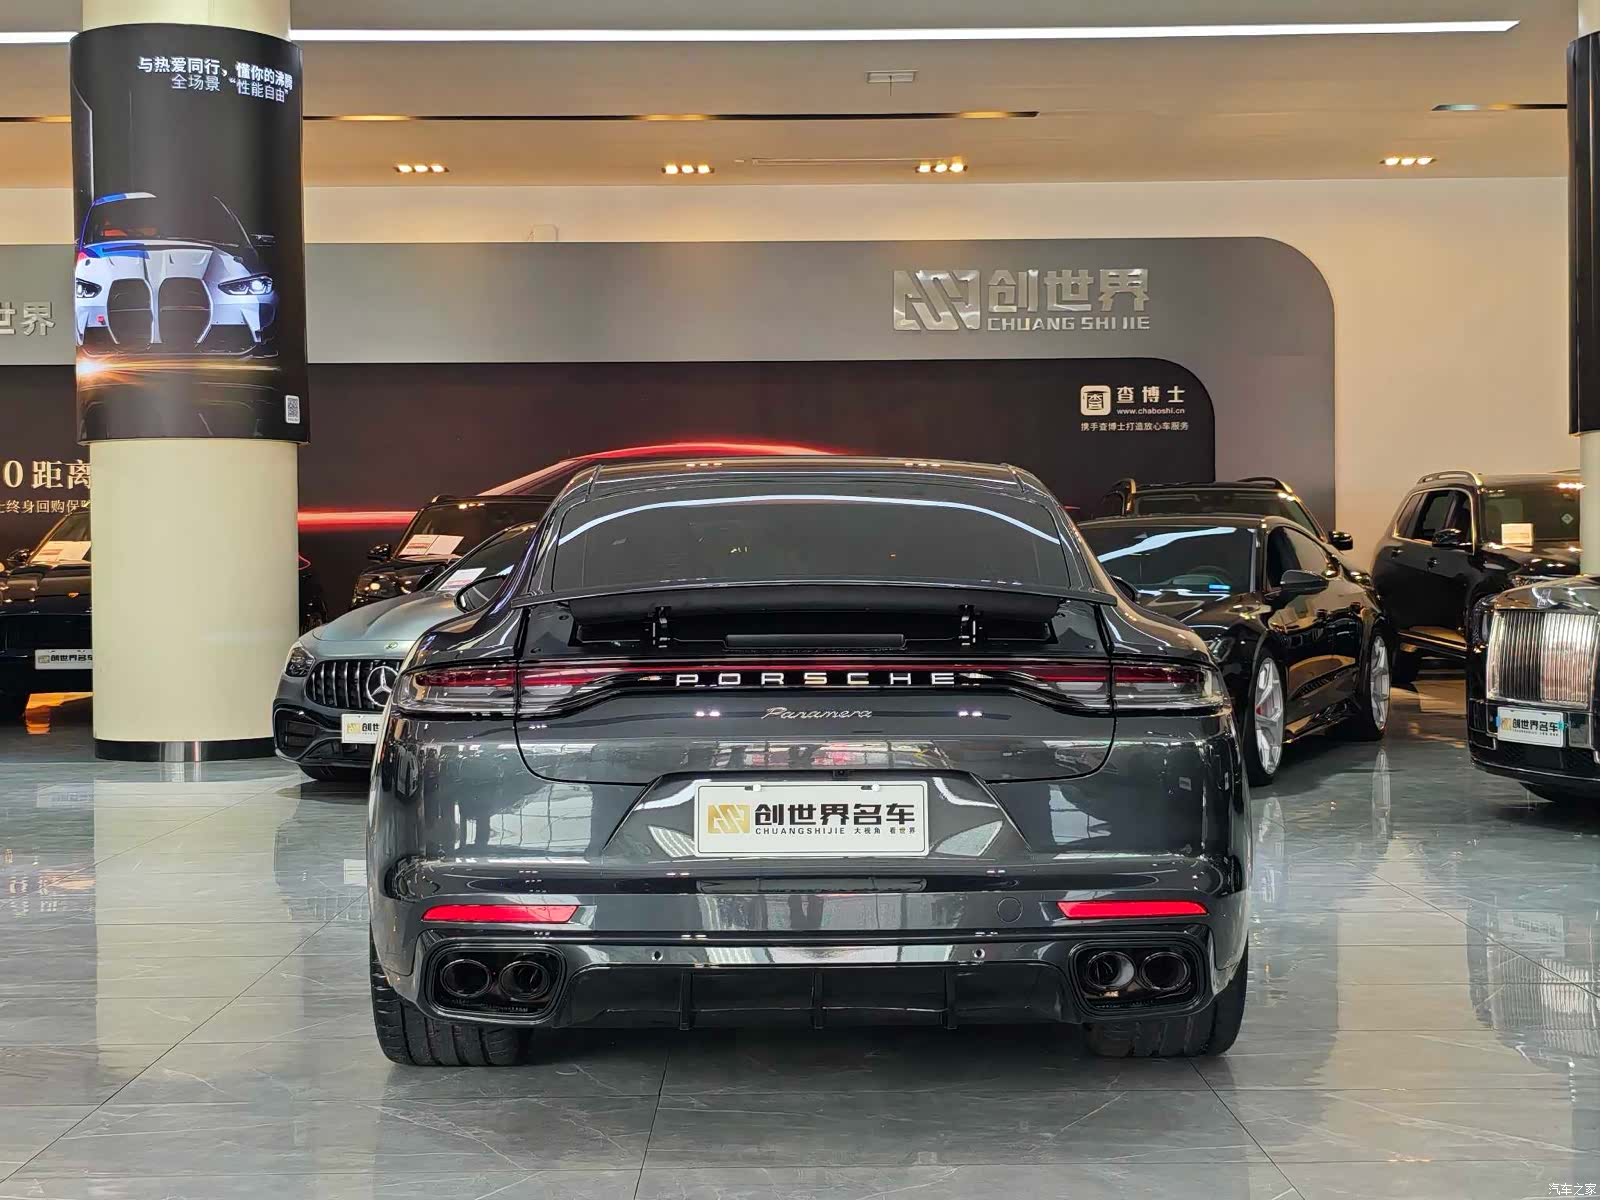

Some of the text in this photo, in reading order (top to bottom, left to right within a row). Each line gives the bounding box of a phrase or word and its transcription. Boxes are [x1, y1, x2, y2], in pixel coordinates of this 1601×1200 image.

[988, 269, 1150, 313] 创世界
[987, 317, 1075, 331] CHUANG
[1081, 317, 1116, 331] SHI
[1116, 385, 1186, 404] 查博士
[1116, 407, 1186, 416] www.chaboshi.cn
[1080, 421, 1190, 432] 携手查博士打造放心车服务
[31, 459, 91, 490] 距离
[675, 672, 955, 687] PORSCHE
[761, 706, 873, 720] Panamera
[754, 803, 916, 826] 创世界名车
[755, 826, 916, 836] CHUANGSHIJIE 大视角 看世界
